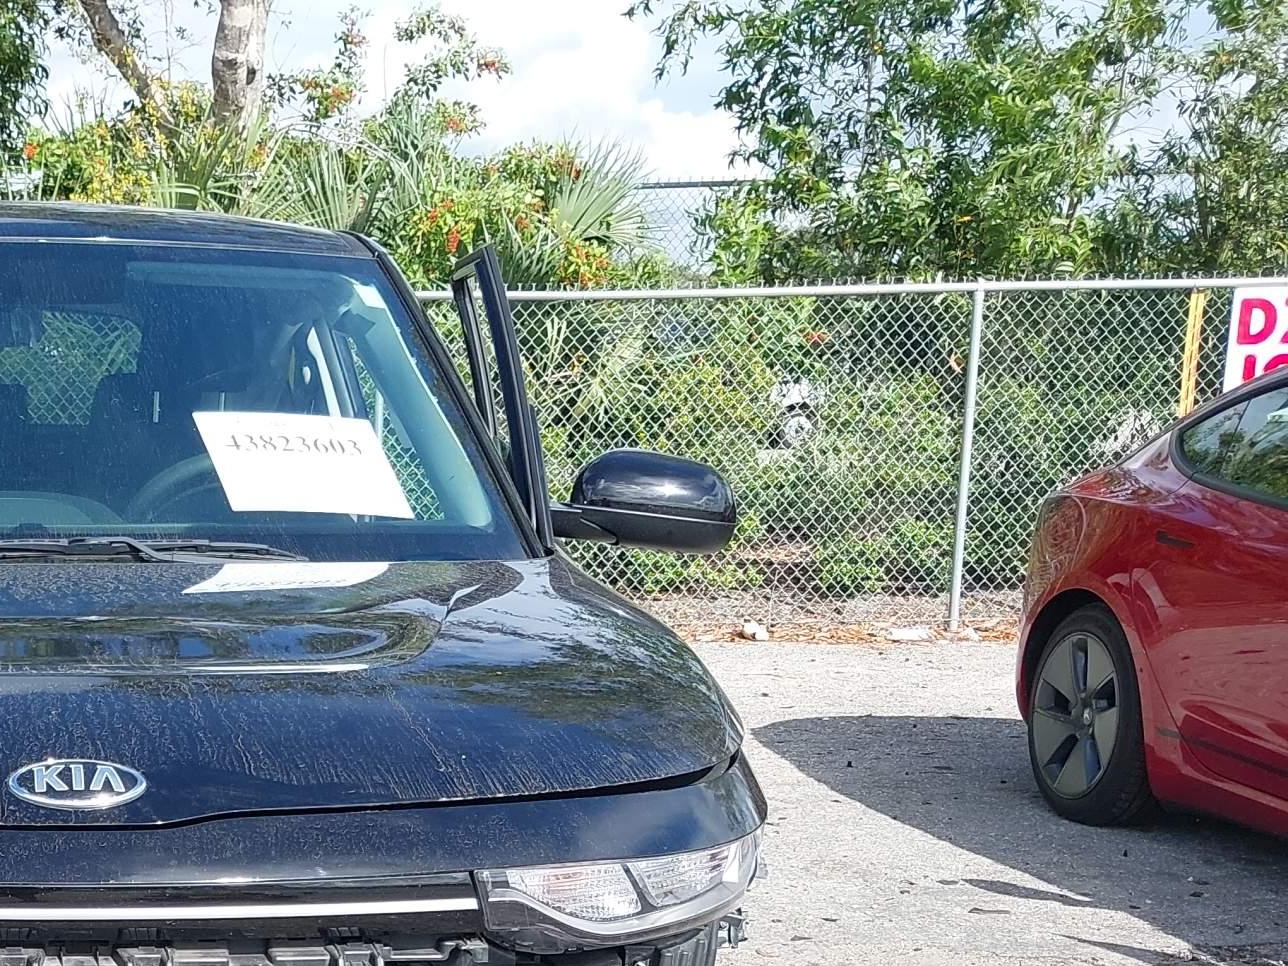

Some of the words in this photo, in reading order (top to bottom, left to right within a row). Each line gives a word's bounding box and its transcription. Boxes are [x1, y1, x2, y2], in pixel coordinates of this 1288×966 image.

[1236, 298, 1288, 345] D
[1241, 353, 1288, 382] 1
[223, 433, 364, 456] 43823603
[31, 764, 126, 792] KIA
